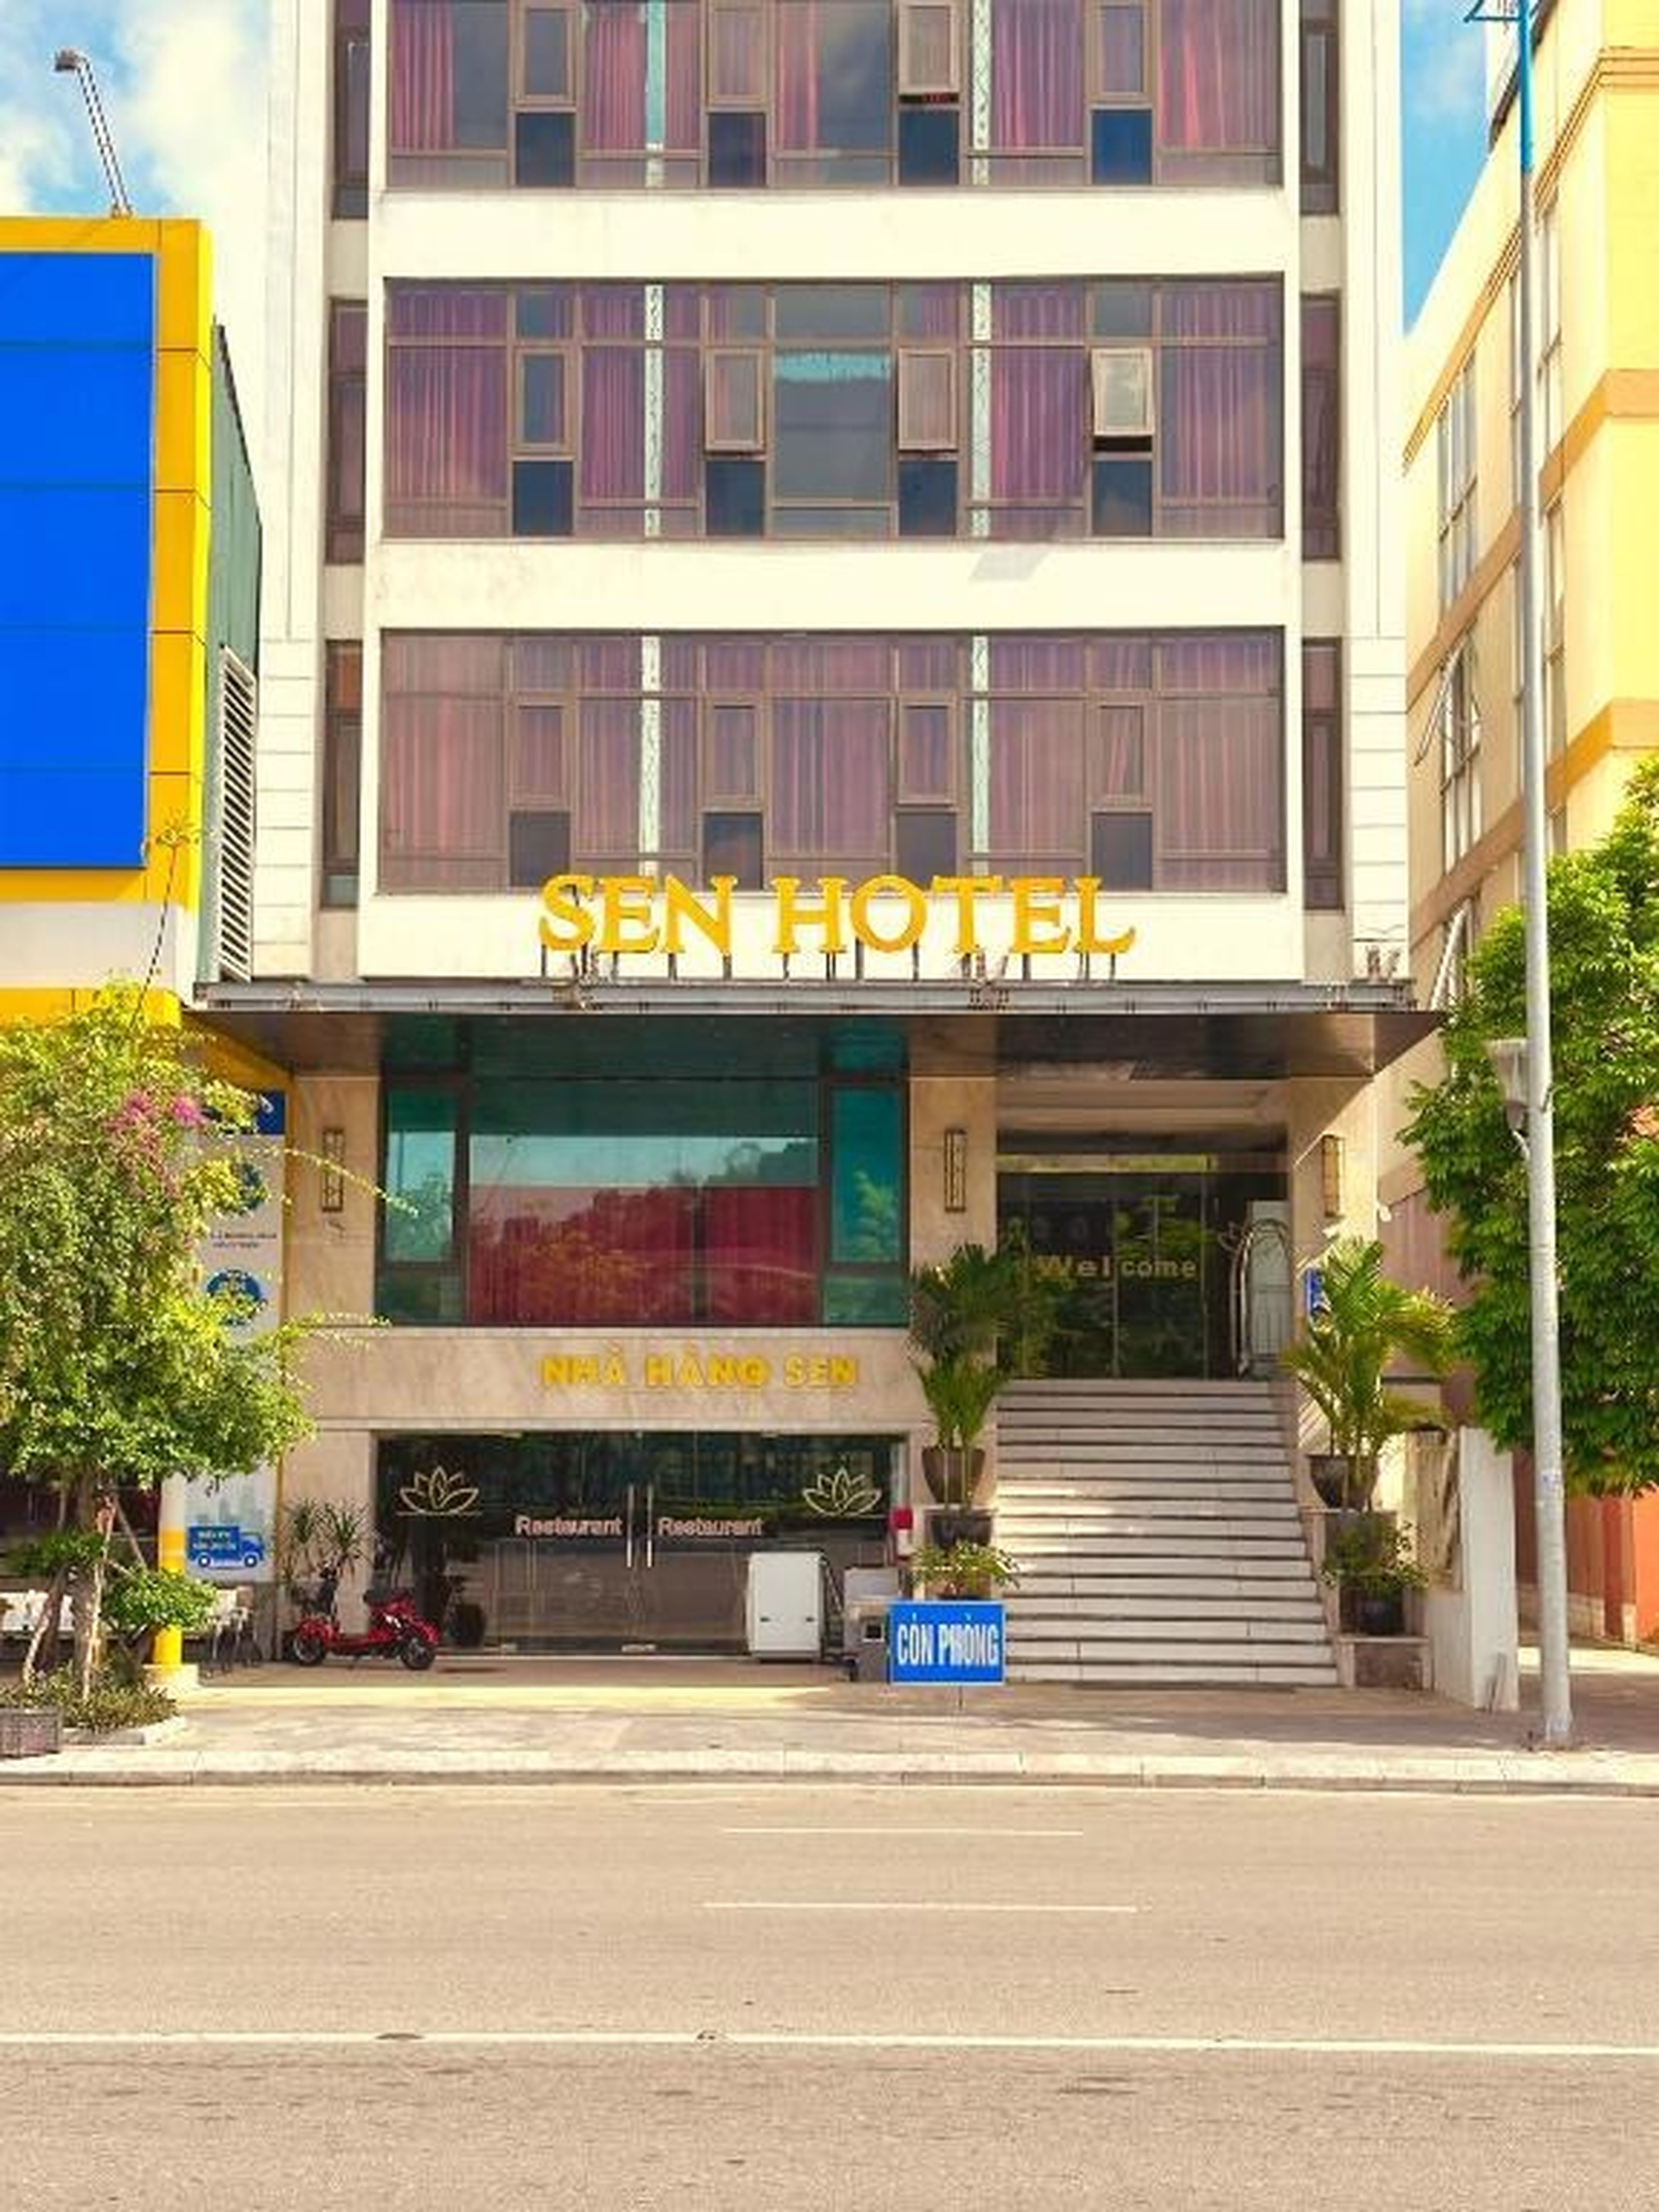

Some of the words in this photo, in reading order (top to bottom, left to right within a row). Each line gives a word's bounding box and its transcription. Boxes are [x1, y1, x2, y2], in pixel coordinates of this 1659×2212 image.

[538, 874, 738, 954] SEN
[771, 875, 1136, 953] HOTEL
[1037, 1255, 1196, 1278] Welcome
[783, 1356, 858, 1387] SEN
[516, 1516, 622, 1536] Restaurant
[658, 1516, 764, 1536] Restaurant
[938, 1613, 1000, 1666] PHÒNG
